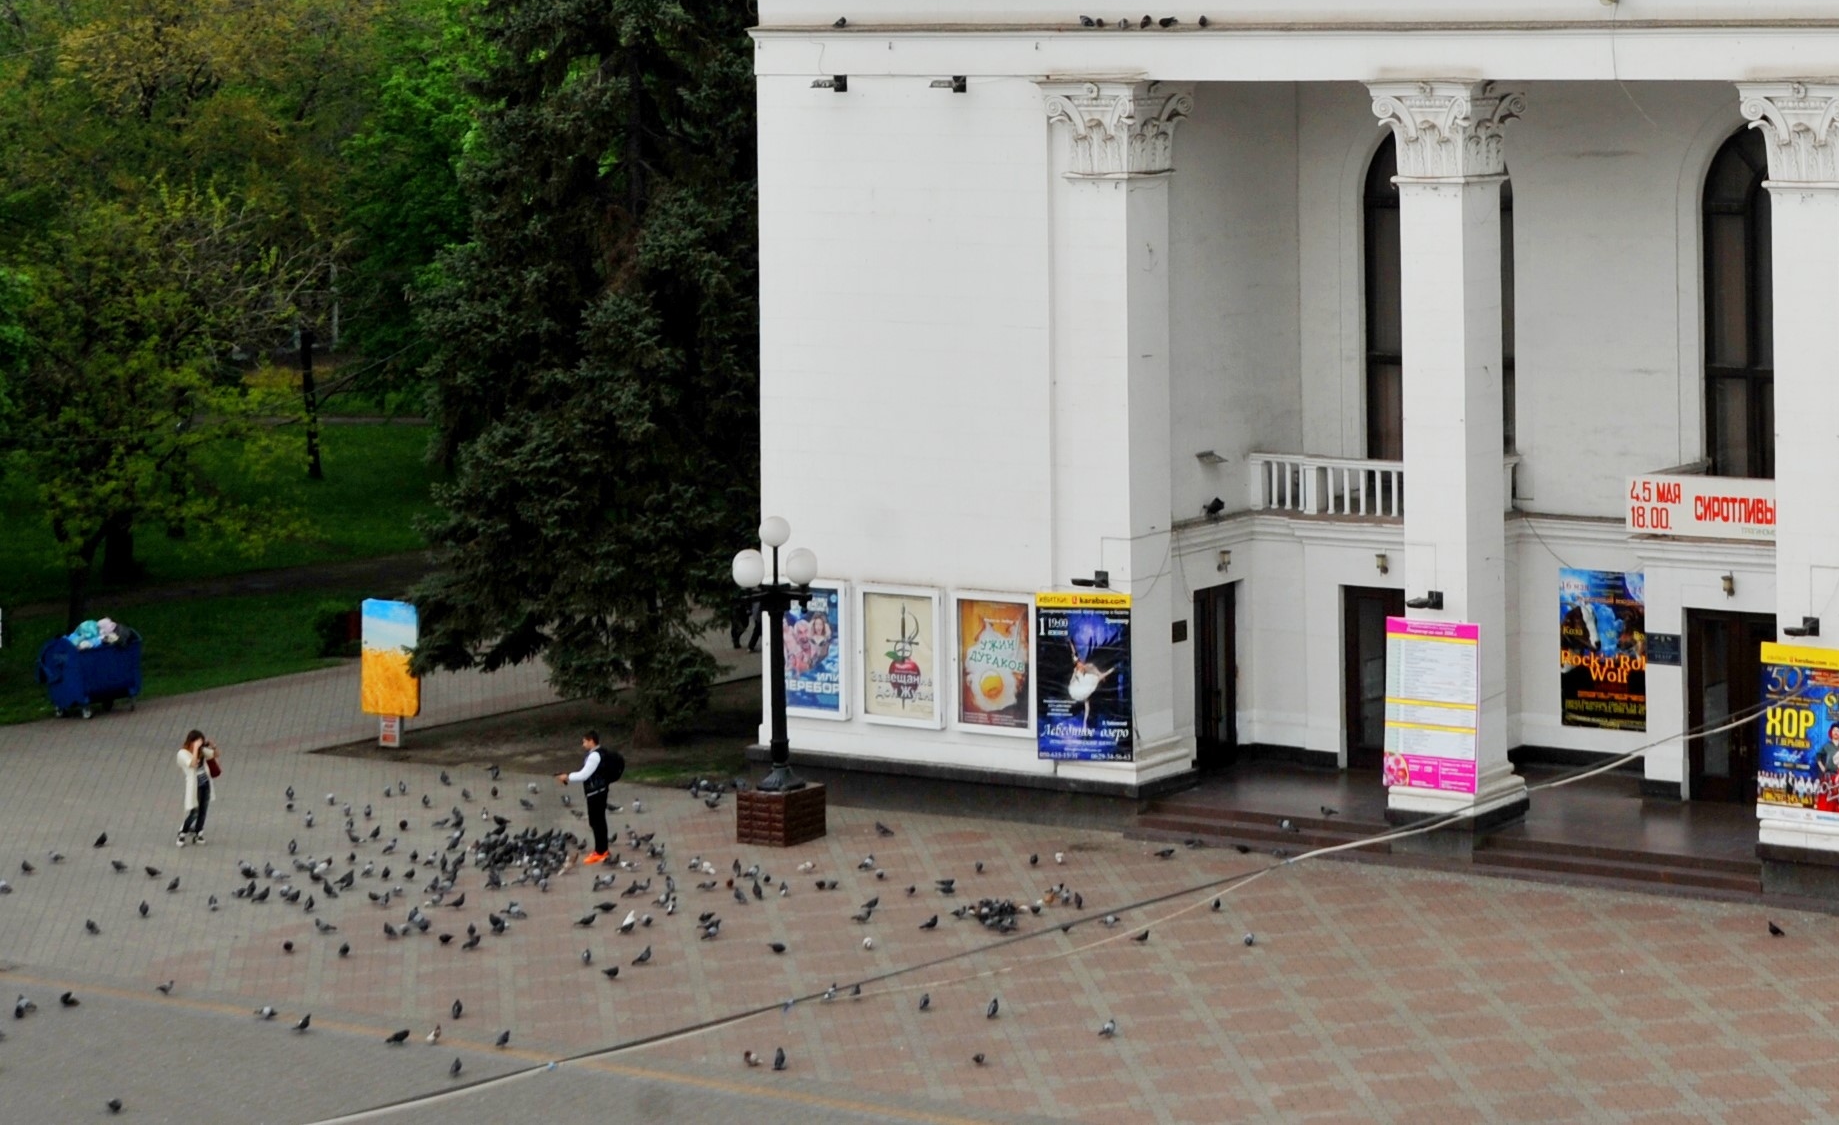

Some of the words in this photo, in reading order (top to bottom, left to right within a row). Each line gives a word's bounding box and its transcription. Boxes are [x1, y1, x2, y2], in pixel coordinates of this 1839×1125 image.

[1656, 482, 1681, 504] МАЯ
[1079, 596, 1127, 605] karabas.com
[980, 639, 1015, 651] УЖИН
[968, 650, 1025, 672] ДУРАКОВ
[1590, 667, 1630, 684] Wolf
[1765, 705, 1816, 739] ХОР
